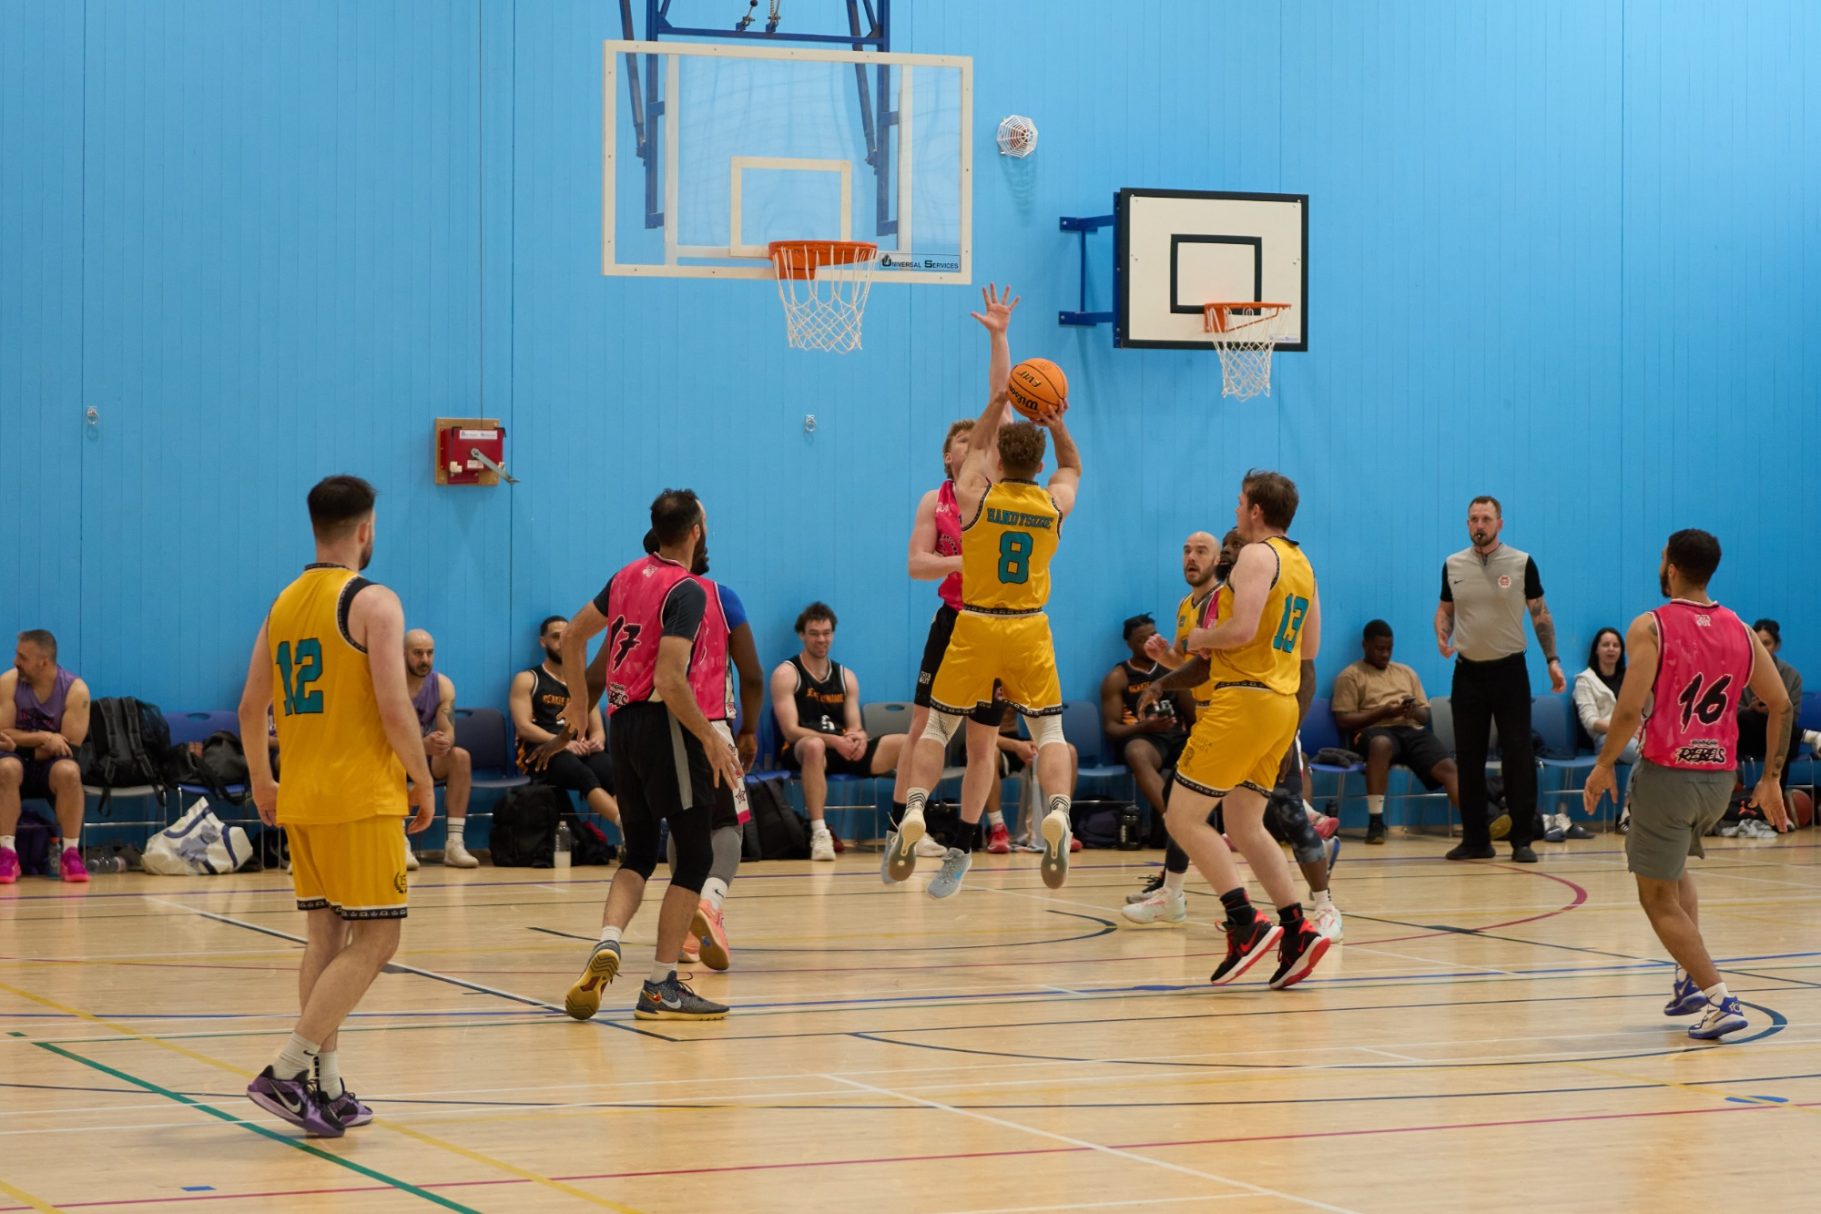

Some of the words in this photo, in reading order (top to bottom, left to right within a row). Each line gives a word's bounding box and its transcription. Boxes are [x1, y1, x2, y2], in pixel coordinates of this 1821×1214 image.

[998, 531, 1034, 584] 8
[610, 615, 642, 673] 17
[1273, 593, 1309, 653] 13
[276, 638, 324, 716] 12
[1678, 672, 1733, 734] 16
